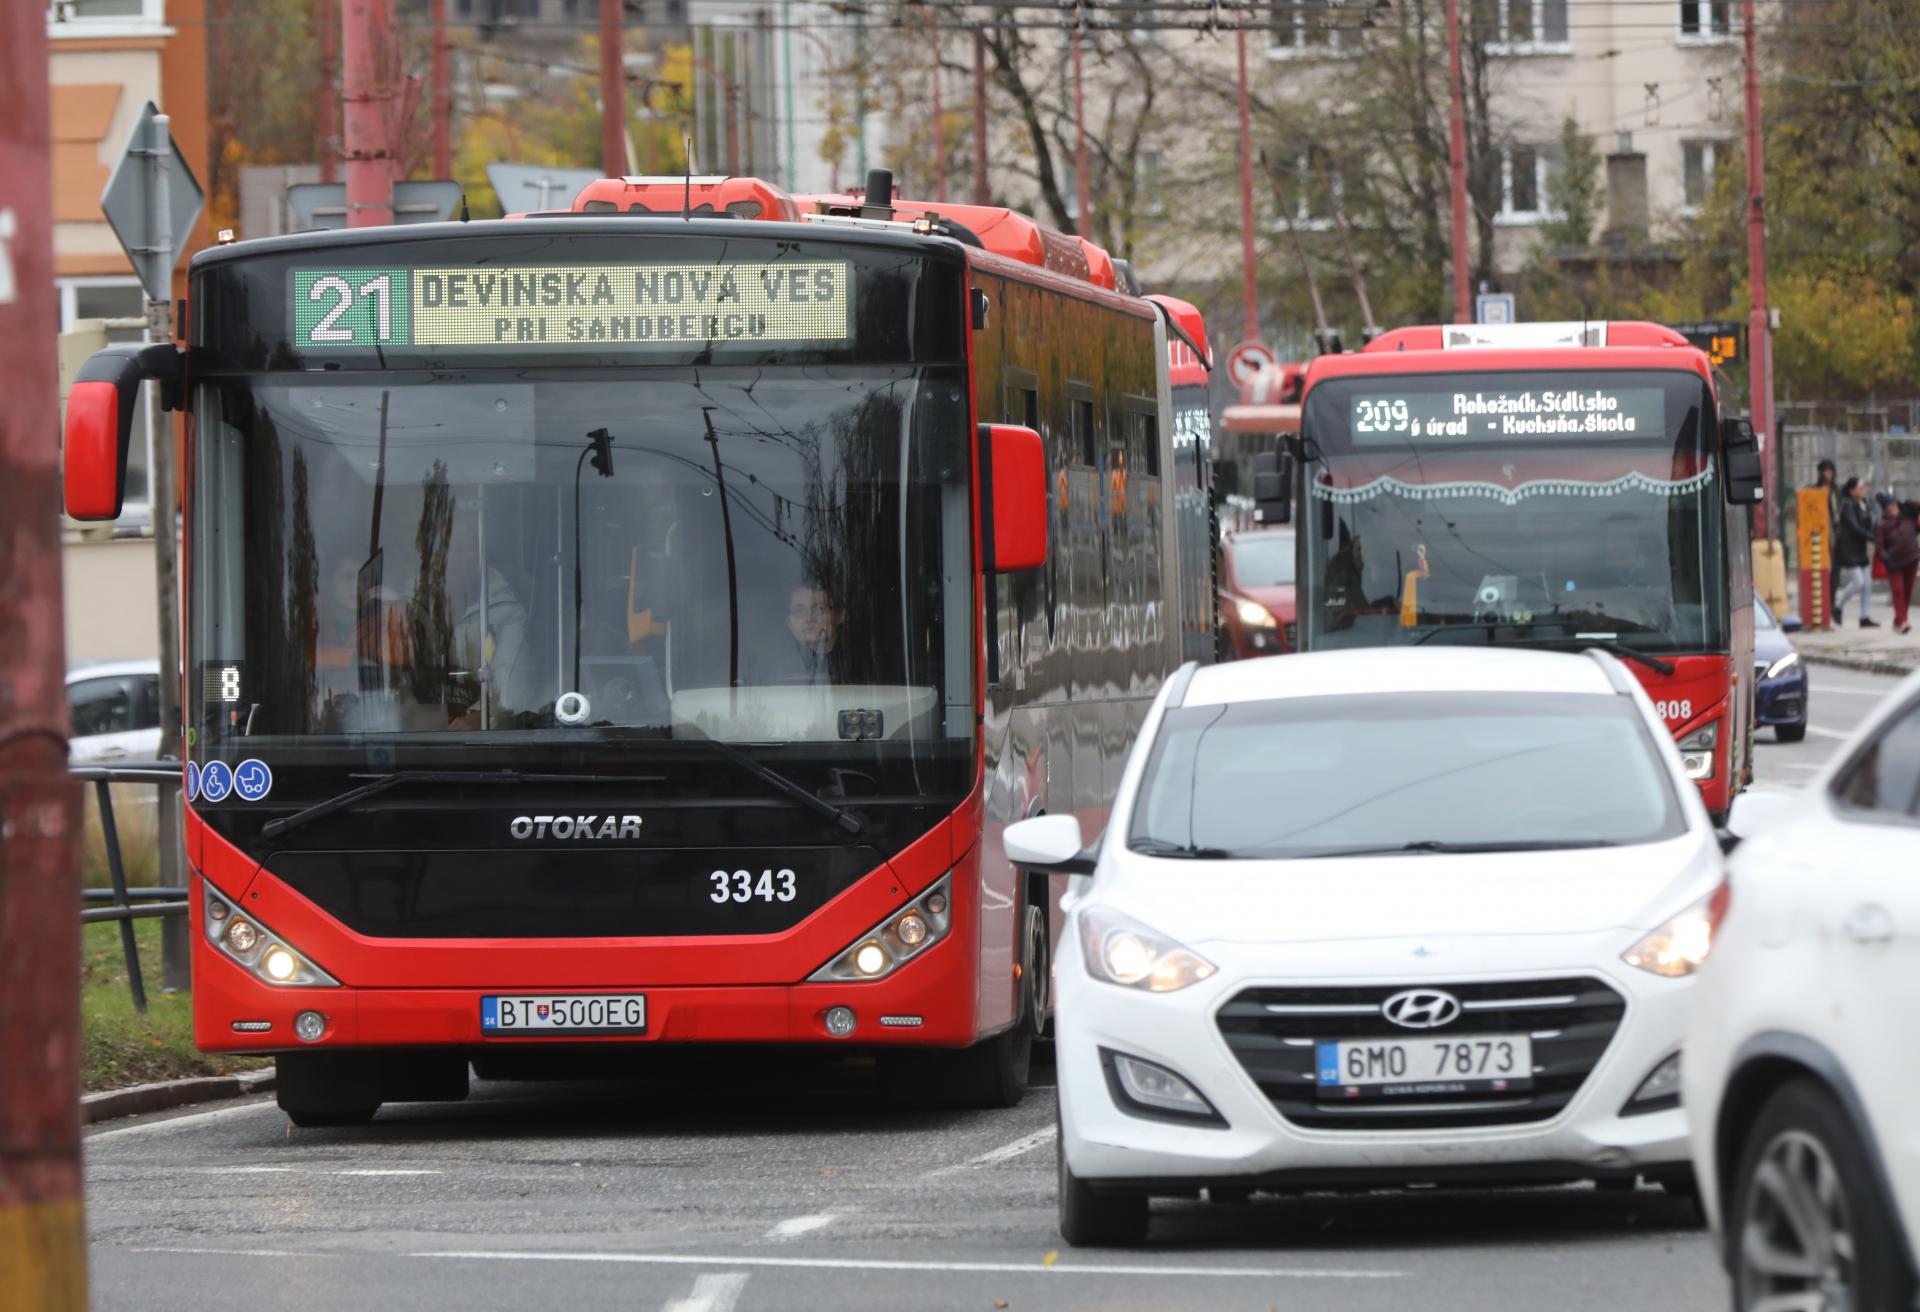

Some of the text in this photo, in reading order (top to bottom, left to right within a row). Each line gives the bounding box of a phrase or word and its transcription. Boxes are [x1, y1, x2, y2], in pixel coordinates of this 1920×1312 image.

[421, 265, 834, 308] DEVÍNSKA NOVÁ VES
[310, 274, 391, 341] 21
[494, 313, 766, 343] PRI SANDBERGU
[1355, 399, 1409, 432] 209
[1426, 416, 1468, 436] úrad
[221, 667, 241, 702] 8
[510, 815, 642, 839] OTOKAR
[710, 868, 797, 903] 3343
[501, 999, 641, 1027] BT 500EG
[1434, 1042, 1514, 1076] 7873
